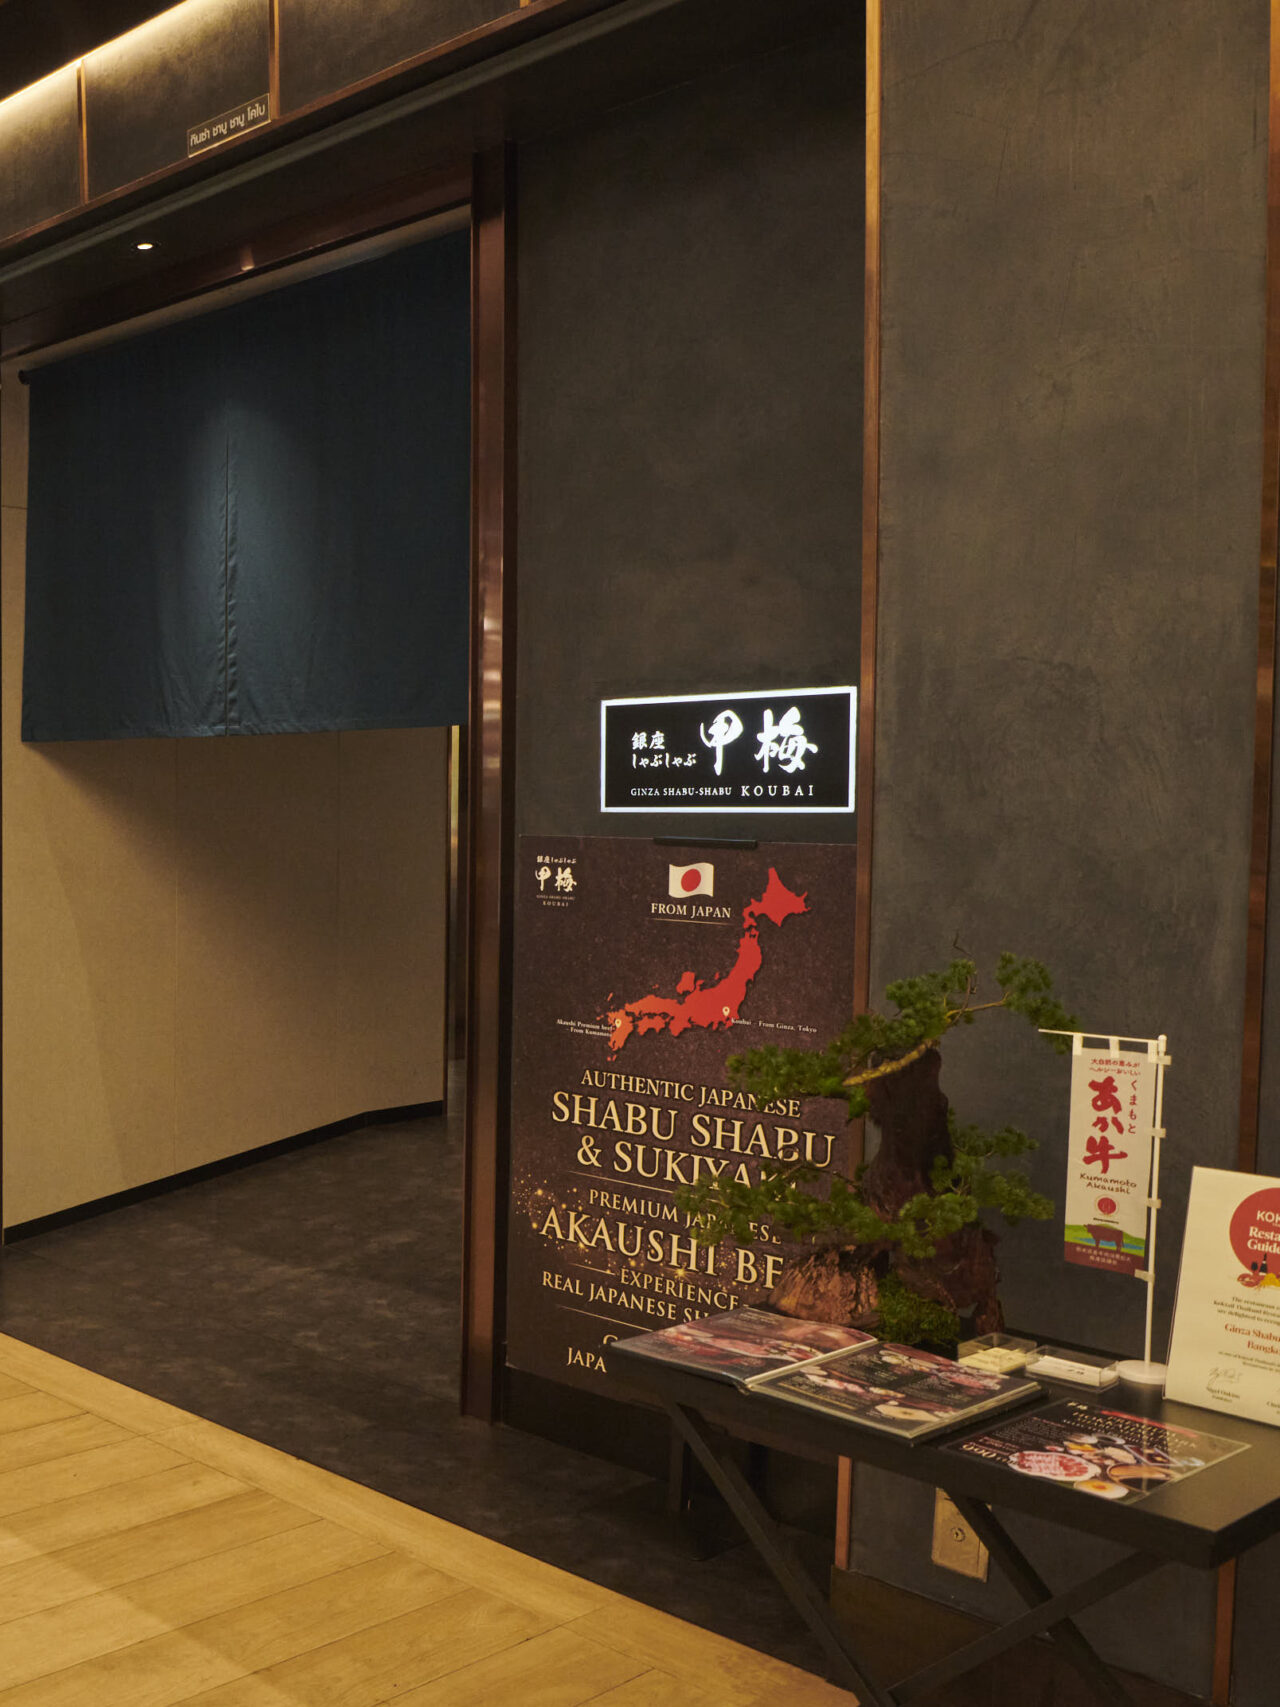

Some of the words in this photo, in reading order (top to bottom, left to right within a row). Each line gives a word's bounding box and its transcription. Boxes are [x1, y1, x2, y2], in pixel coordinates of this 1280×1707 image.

[212, 120, 228, 137] ชาบู
[230, 113, 245, 129] ชาบู
[631, 730, 665, 750] 銀座
[632, 752, 697, 769] しゃぶしゃぶ
[630, 787, 660, 797] GINZA
[662, 786, 733, 797] SHABU-SHABU
[740, 785, 815, 797] KOUBAI
[651, 902, 687, 916] FROM
[690, 905, 732, 919] JAPAN
[759, 1020, 775, 1028] From
[797, 1024, 818, 1034] Tokyo
[581, 1069, 694, 1101] AUTHENTIC
[1128, 1079, 1138, 1135] くまもと
[551, 1090, 678, 1141] SHABU
[690, 1113, 836, 1168] SHABU
[1082, 1076, 1129, 1174] あか牛
[577, 1135, 602, 1168] &
[613, 1140, 796, 1198] SUKIYA
[1080, 1172, 1137, 1188] Kumamoto
[1086, 1181, 1131, 1194] Akaushi
[589, 1189, 679, 1223] PREMIUM
[539, 1206, 718, 1276] AKAUSHI
[542, 1271, 584, 1296] REAL
[588, 1283, 677, 1320] JAPANESE
[1225, 1323, 1251, 1336] Ginza
[566, 1347, 608, 1374] JAPA
